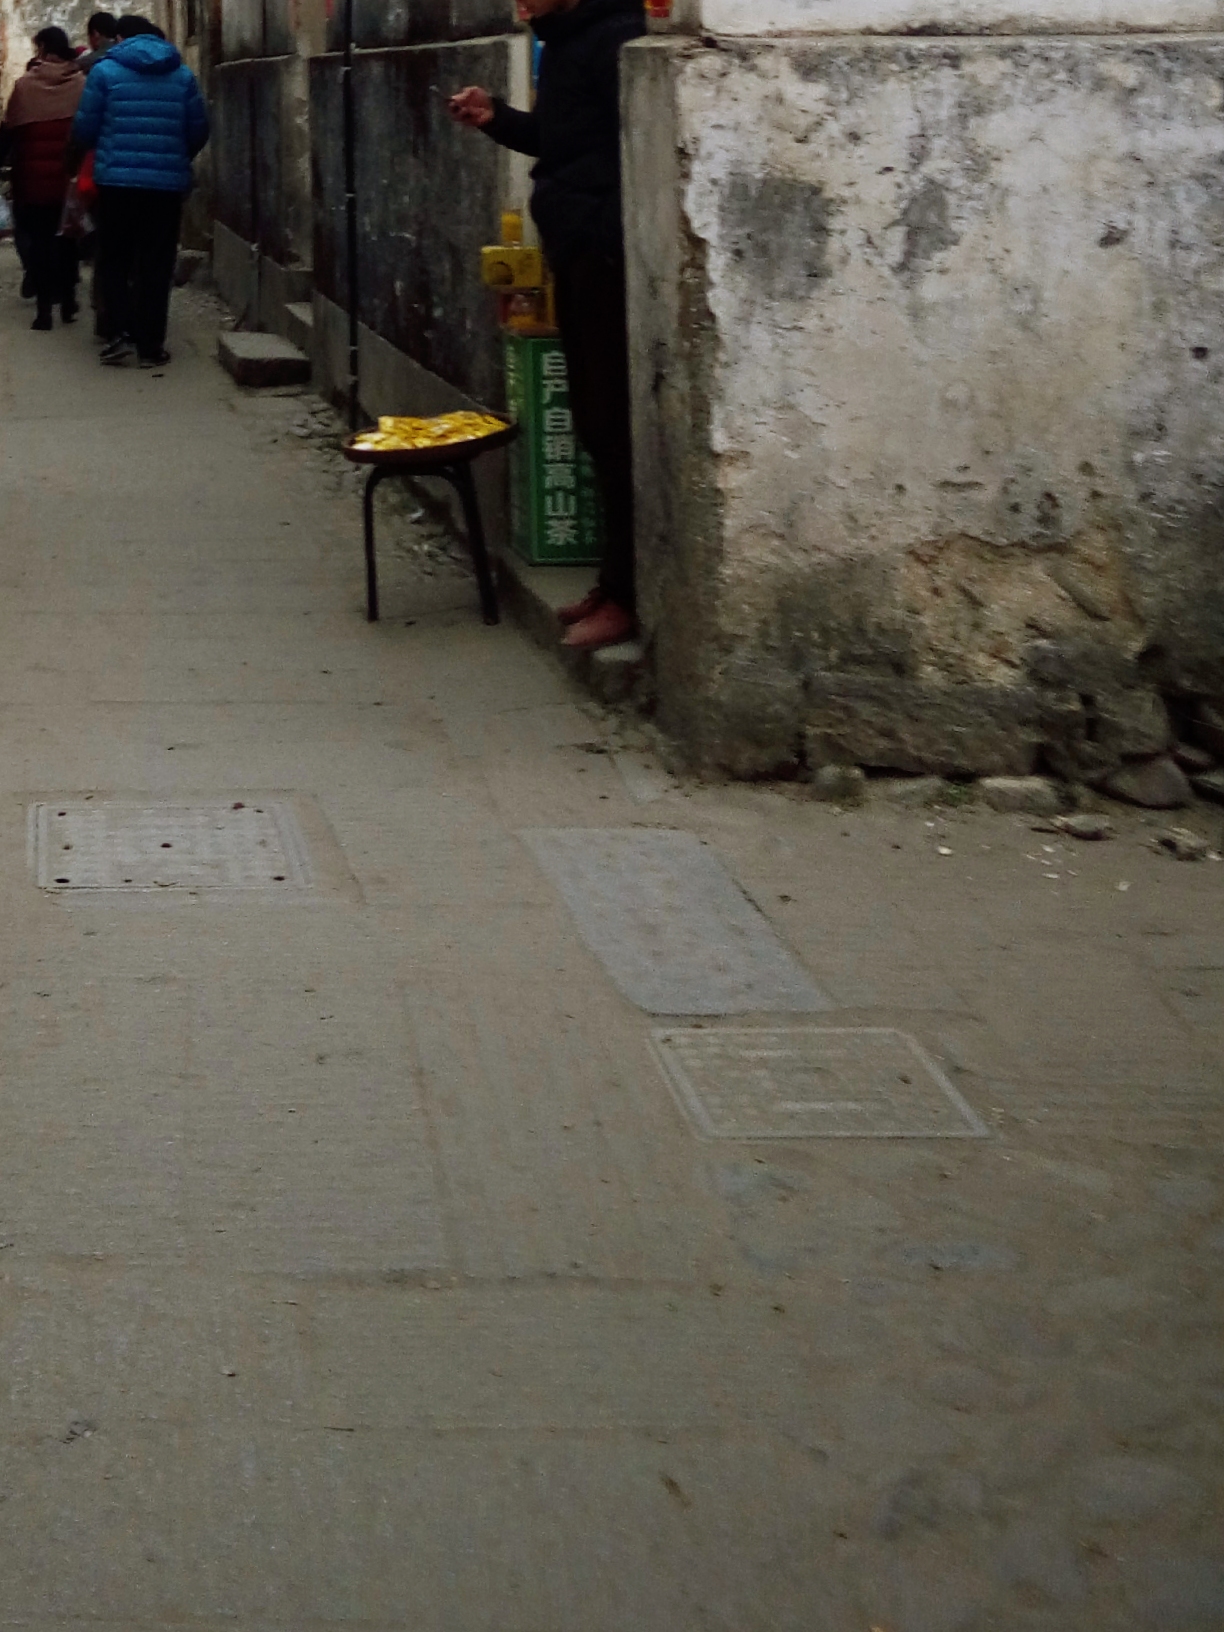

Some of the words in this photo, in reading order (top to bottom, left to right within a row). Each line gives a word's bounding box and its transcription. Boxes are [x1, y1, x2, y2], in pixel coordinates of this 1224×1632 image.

[541, 349, 579, 546] 自产自销高山茶
